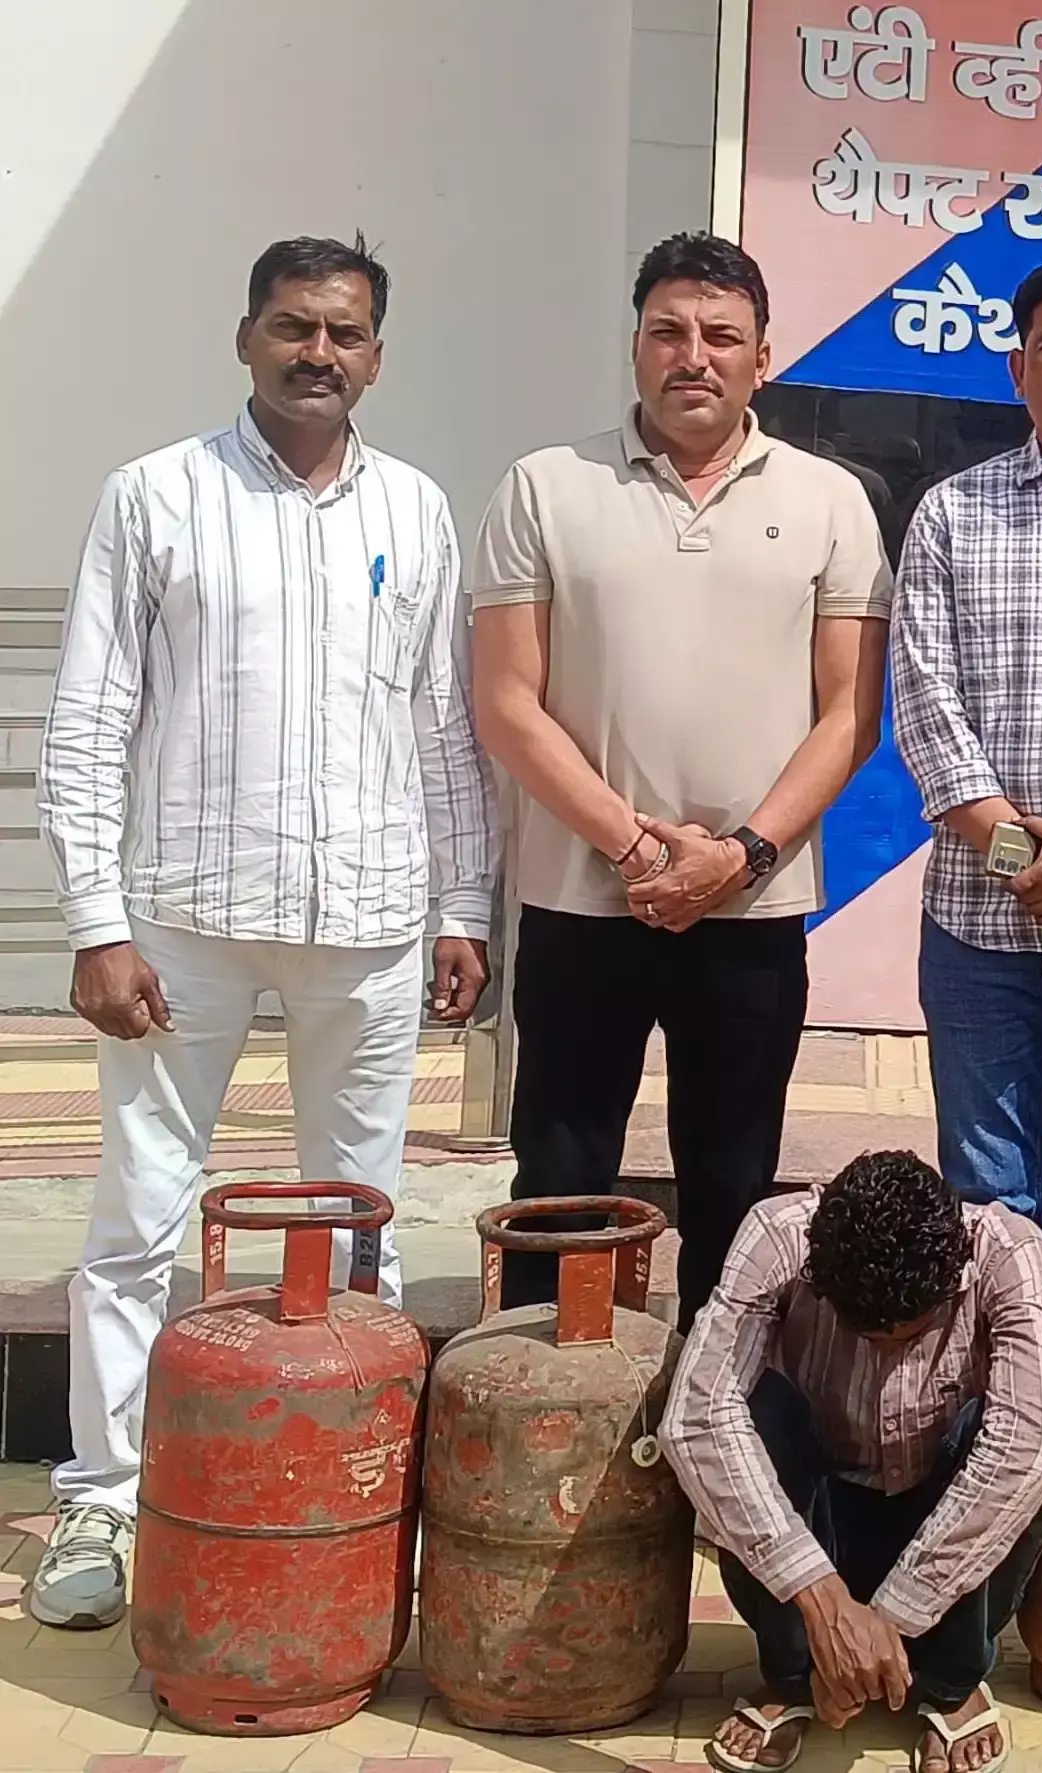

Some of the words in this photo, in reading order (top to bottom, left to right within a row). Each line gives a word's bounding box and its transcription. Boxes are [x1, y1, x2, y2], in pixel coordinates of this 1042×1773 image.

[797, 4, 935, 102] एंटी
[812, 127, 990, 235] थैफ्ट
[891, 261, 1023, 355] कैथ
